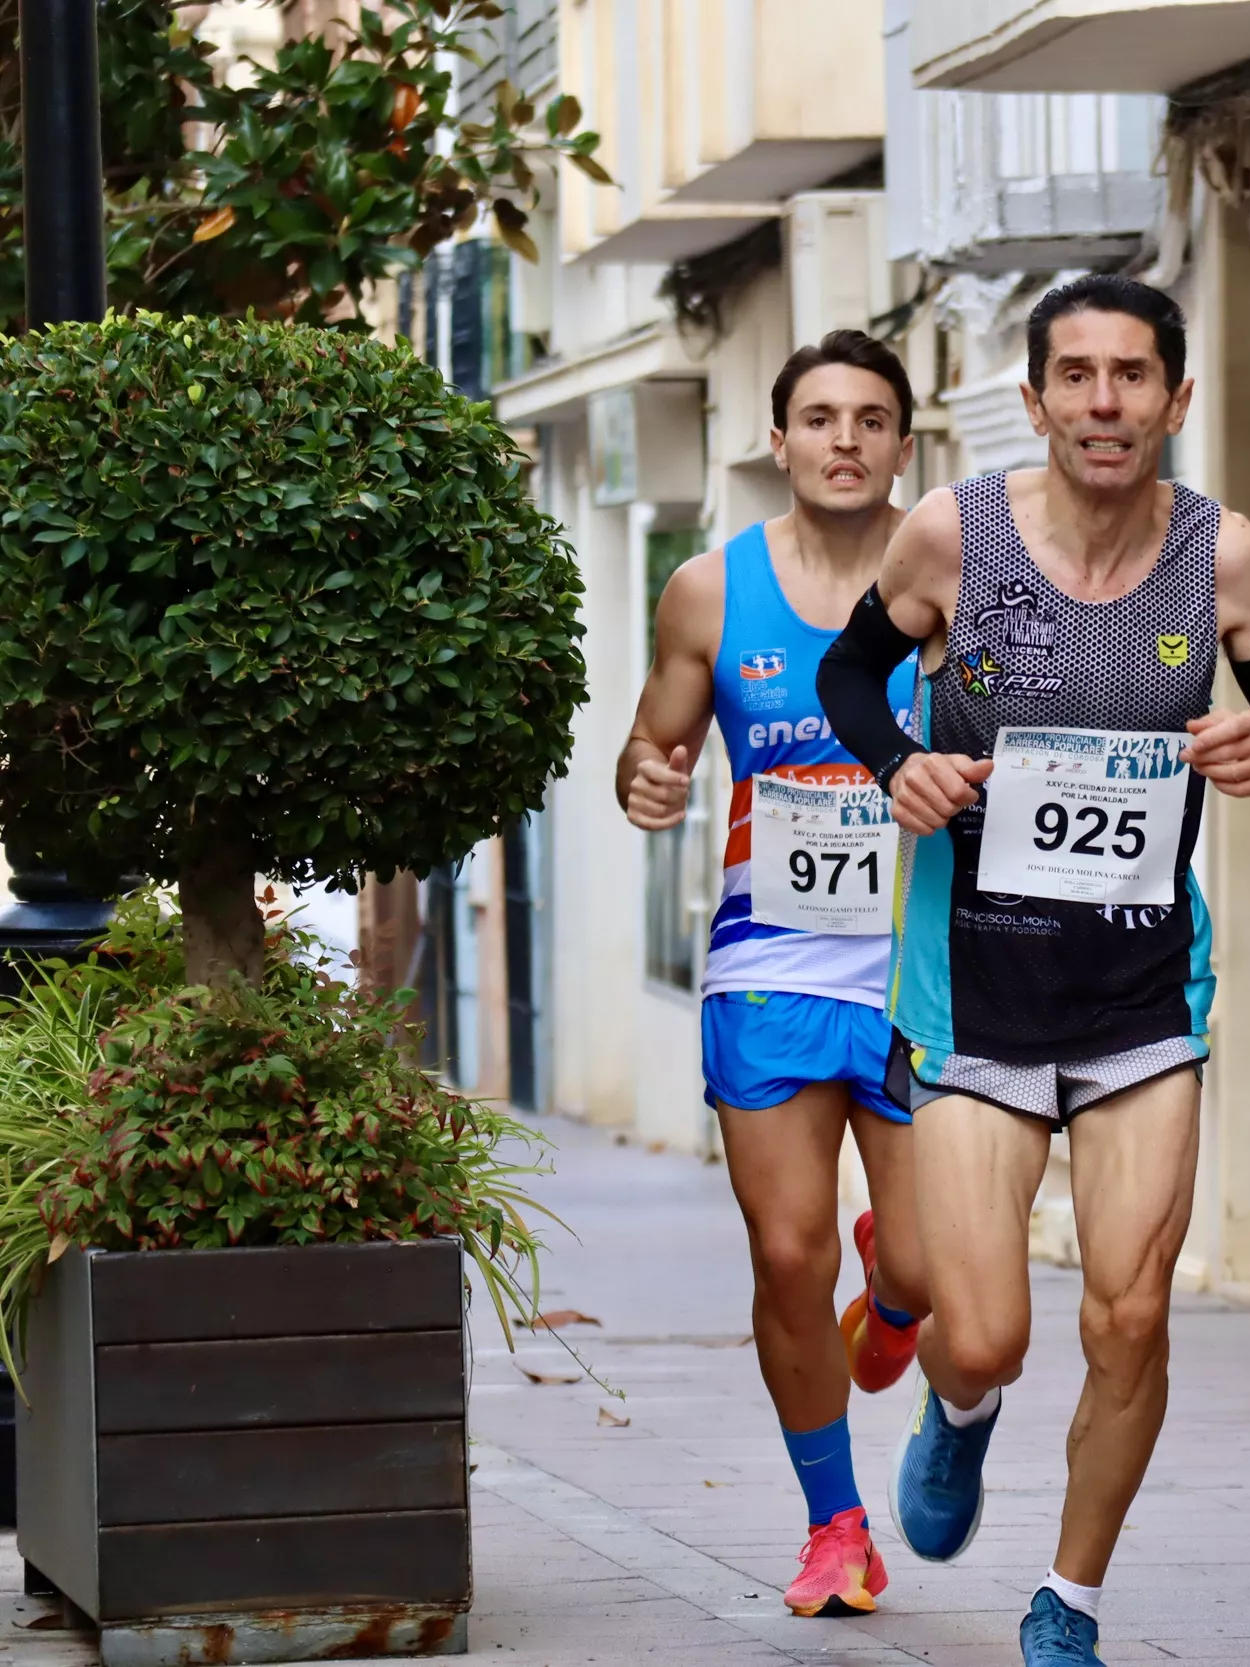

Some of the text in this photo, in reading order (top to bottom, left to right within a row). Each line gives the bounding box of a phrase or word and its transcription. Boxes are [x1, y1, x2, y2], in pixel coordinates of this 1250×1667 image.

[1003, 607, 1027, 621] CLUB
[1002, 620, 1055, 635] ATLETISMO
[1005, 646, 1048, 656] LUCENA
[1004, 675, 1063, 691] PDM
[1004, 738, 1106, 755] CARRERAS POPULARES
[1005, 732, 1043, 741] CIRCUITO
[1045, 734, 1093, 746] PROVINCIAL
[1104, 737, 1156, 758] 2024
[1046, 780, 1062, 788] XXV
[1063, 782, 1077, 790] C.P.
[1079, 783, 1107, 792] CIUDAD
[1108, 786, 1118, 794] DE
[758, 789, 837, 808] CARRERAS POPULARES
[839, 788, 884, 809] 2024
[1077, 793, 1088, 801] LA
[1089, 795, 1128, 804] IGUALDAD
[1033, 802, 1147, 860] 925
[789, 850, 879, 895] 971
[1027, 864, 1046, 872] JOSE
[1048, 866, 1074, 875] DIEGO
[1076, 868, 1109, 879] MOLINA
[854, 906, 878, 914] TELLO
[956, 907, 1012, 924] FRANCISCO
